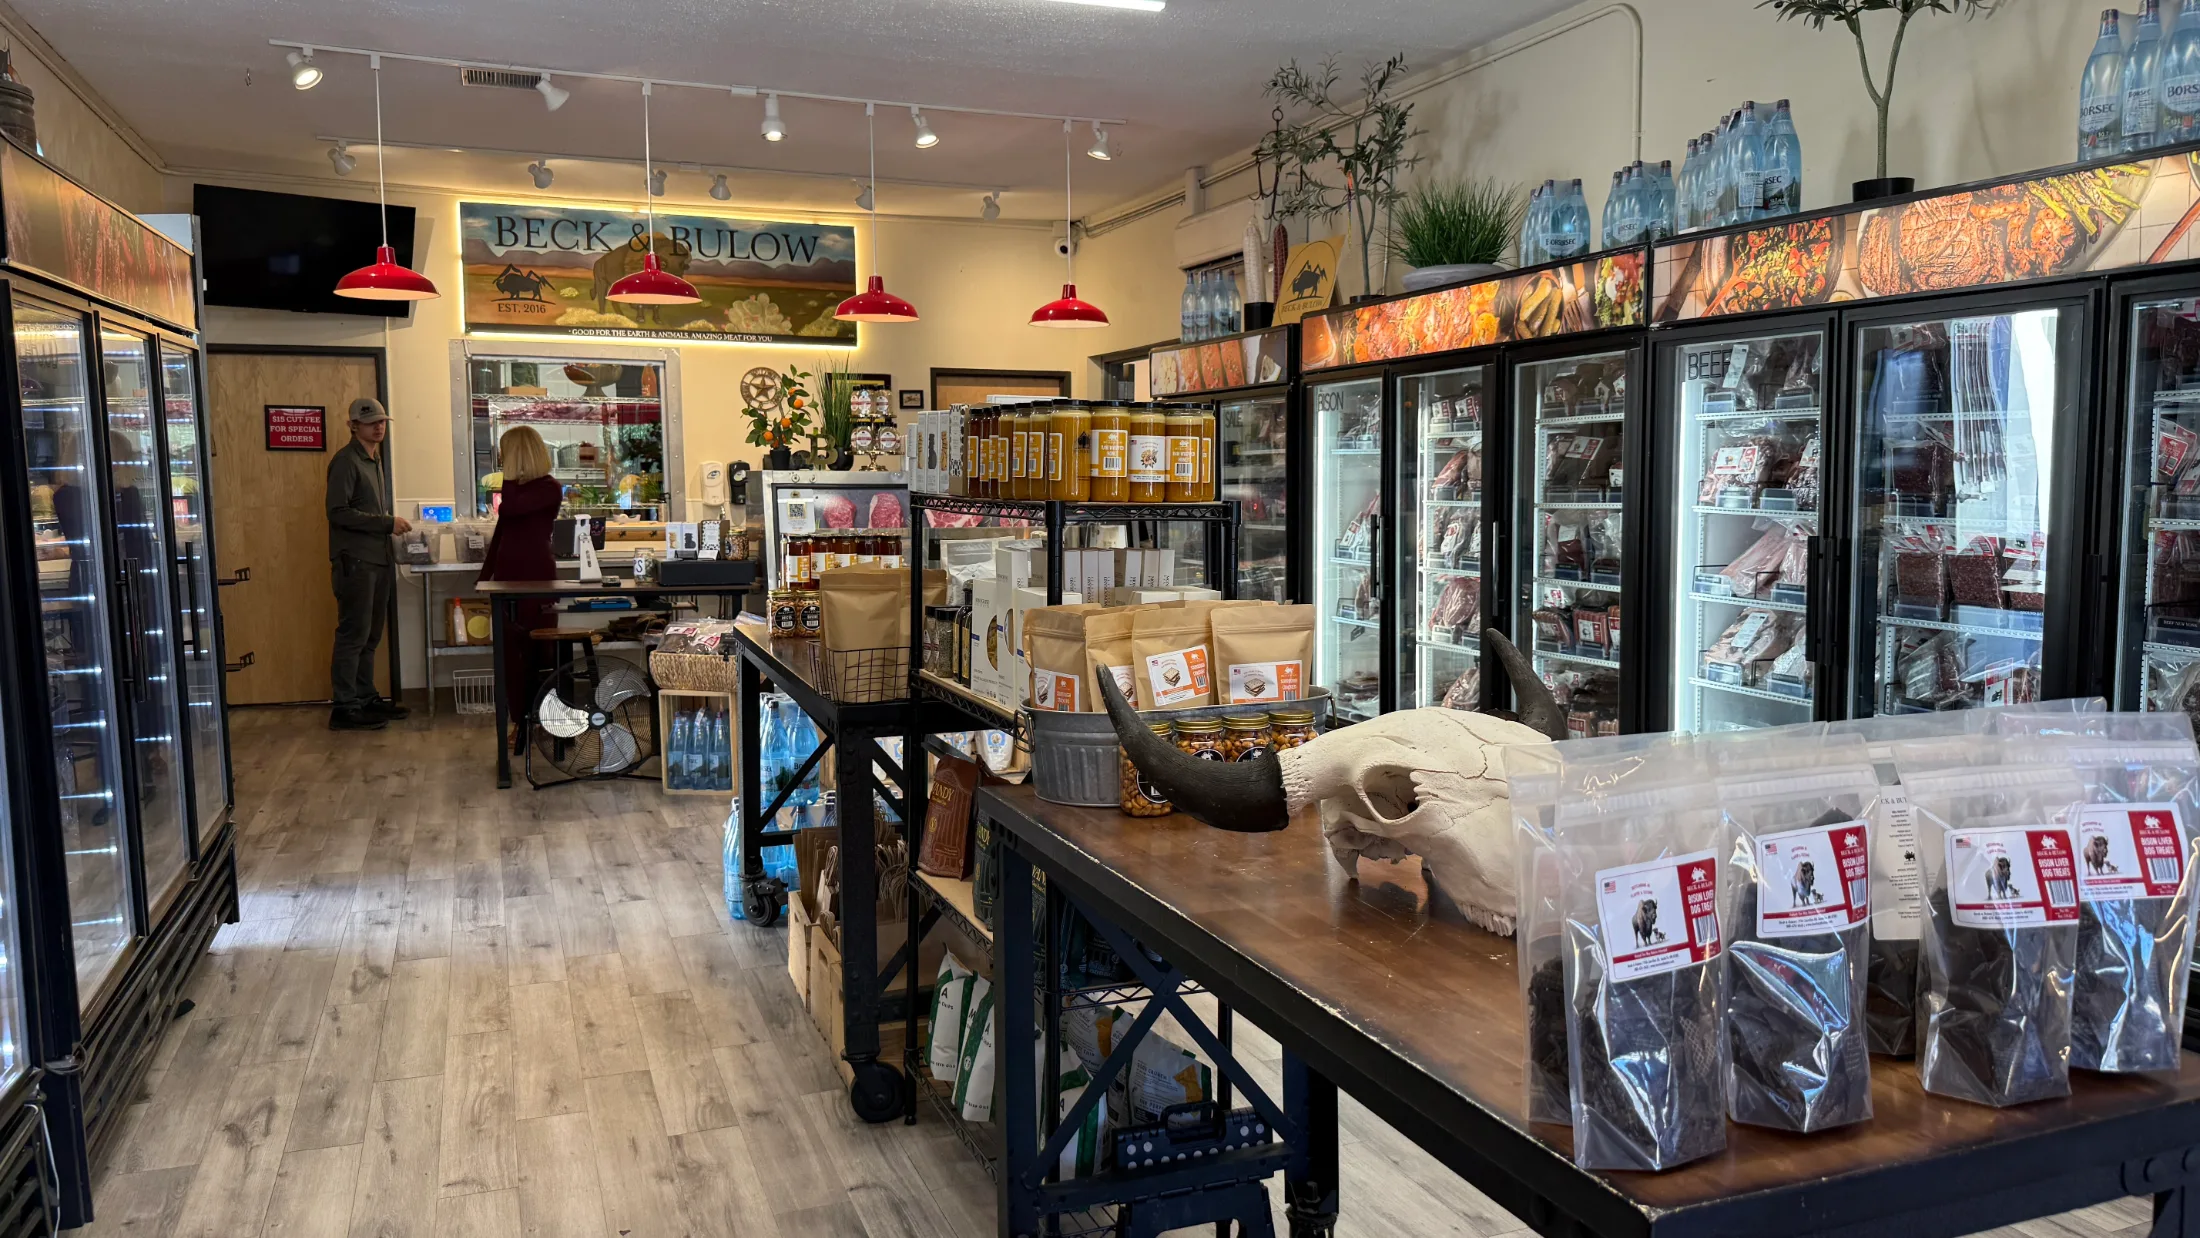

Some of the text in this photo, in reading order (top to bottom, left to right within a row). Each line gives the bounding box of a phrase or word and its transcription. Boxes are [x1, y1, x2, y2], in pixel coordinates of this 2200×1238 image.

[2167, 84, 2200, 98] BORS
[1764, 176, 1782, 184] RSEC
[494, 216, 820, 264] BECK & BULOW
[523, 304, 546, 314] 2016
[1318, 390, 1344, 412] BISON
[1224, 410, 1244, 428] SALE
[2141, 837, 2173, 846] BISON LIVER
[2144, 846, 2175, 855] DOG TREATS
[2038, 858, 2069, 868] BISON LIVER
[2042, 868, 2071, 878] DOG TREATS
[1688, 892, 1703, 904] BISON
[1690, 904, 1701, 914] DOG
